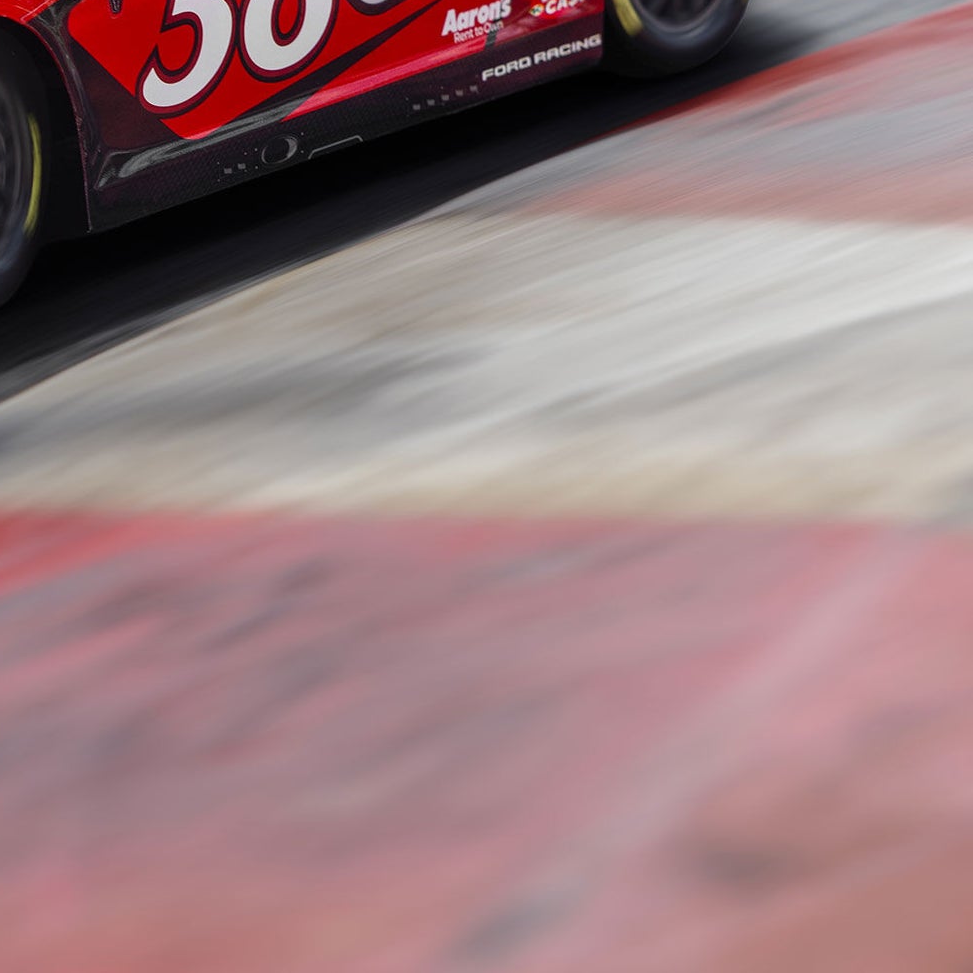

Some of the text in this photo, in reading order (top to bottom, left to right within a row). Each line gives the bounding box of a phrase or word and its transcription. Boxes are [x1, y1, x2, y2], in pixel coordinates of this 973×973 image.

[453, 28, 474, 43] Rent
[474, 26, 485, 37] to
[482, 34, 602, 81] FORD RACING
